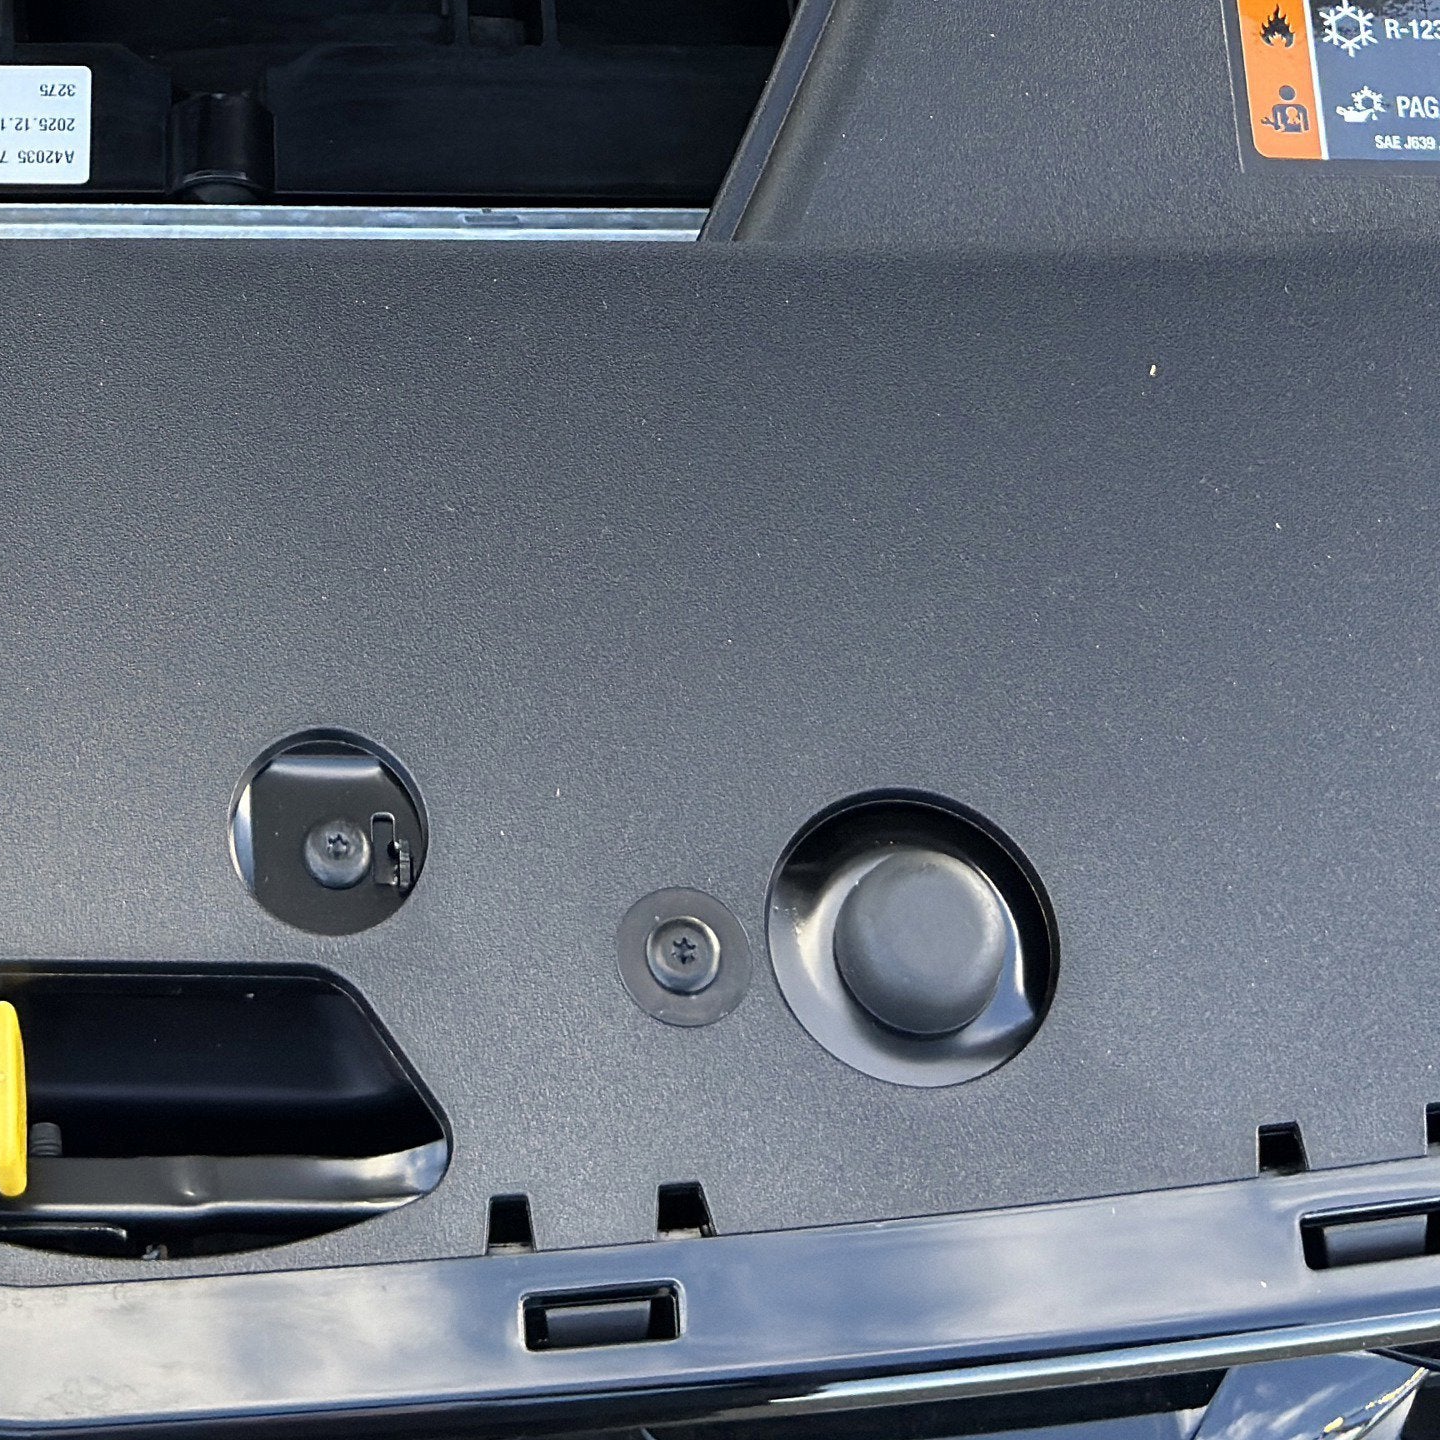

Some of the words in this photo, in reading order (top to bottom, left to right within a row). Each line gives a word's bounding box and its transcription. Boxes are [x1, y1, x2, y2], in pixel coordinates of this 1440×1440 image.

[39, 83, 76, 97] 3275
[1396, 95, 1440, 119] PAG
[1374, 135, 1402, 151] SAE
[18, 149, 75, 164] A42035
